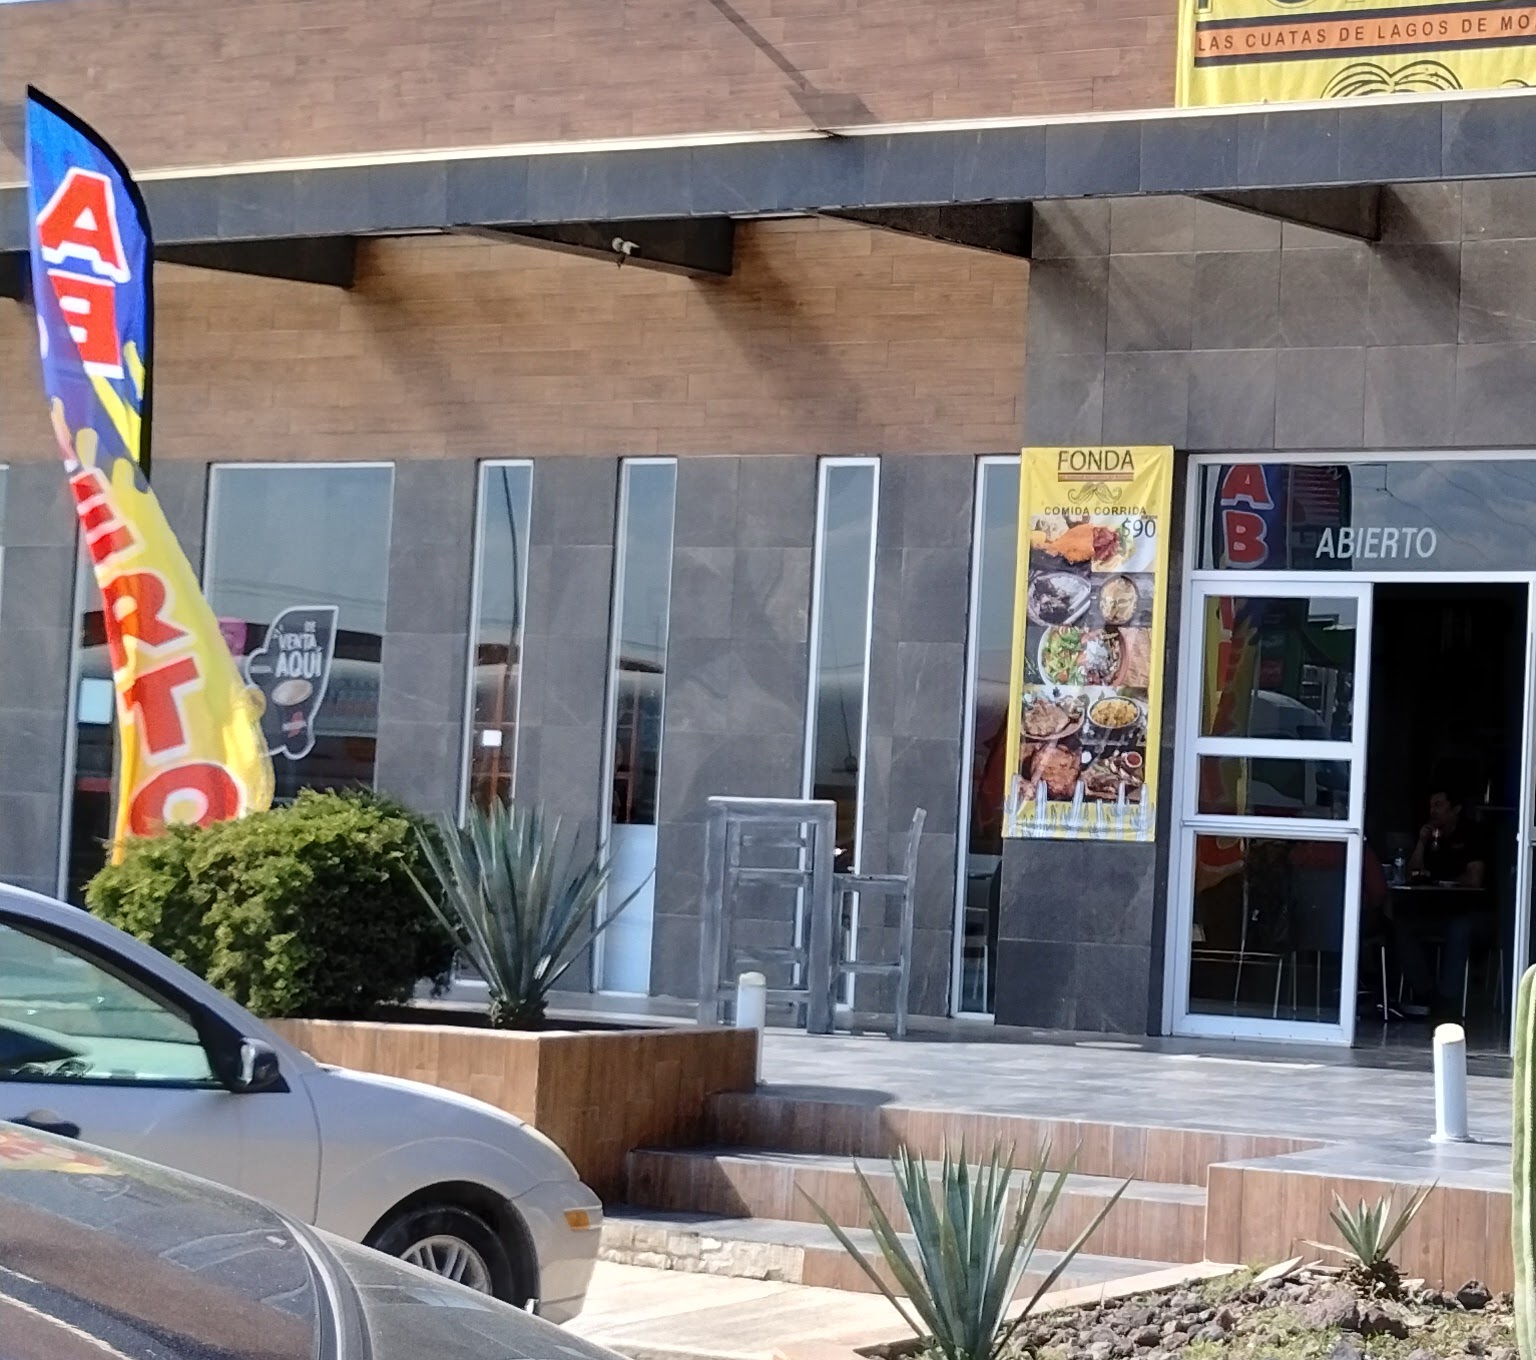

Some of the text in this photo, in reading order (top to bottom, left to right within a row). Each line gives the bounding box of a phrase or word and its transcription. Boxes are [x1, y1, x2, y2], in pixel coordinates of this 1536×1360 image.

[1198, 32, 1235, 52] LAS
[1246, 28, 1327, 48] CUATAS
[1339, 24, 1365, 42] DE
[1378, 19, 1449, 40] LAGOS
[1462, 16, 1488, 33] DE
[1058, 450, 1135, 471] FONDA
[1044, 506, 1148, 516] COMIDA CORRIDA
[1121, 517, 1157, 538] $90
[1315, 527, 1437, 560] ABIERTO
[278, 632, 318, 651] VENTA
